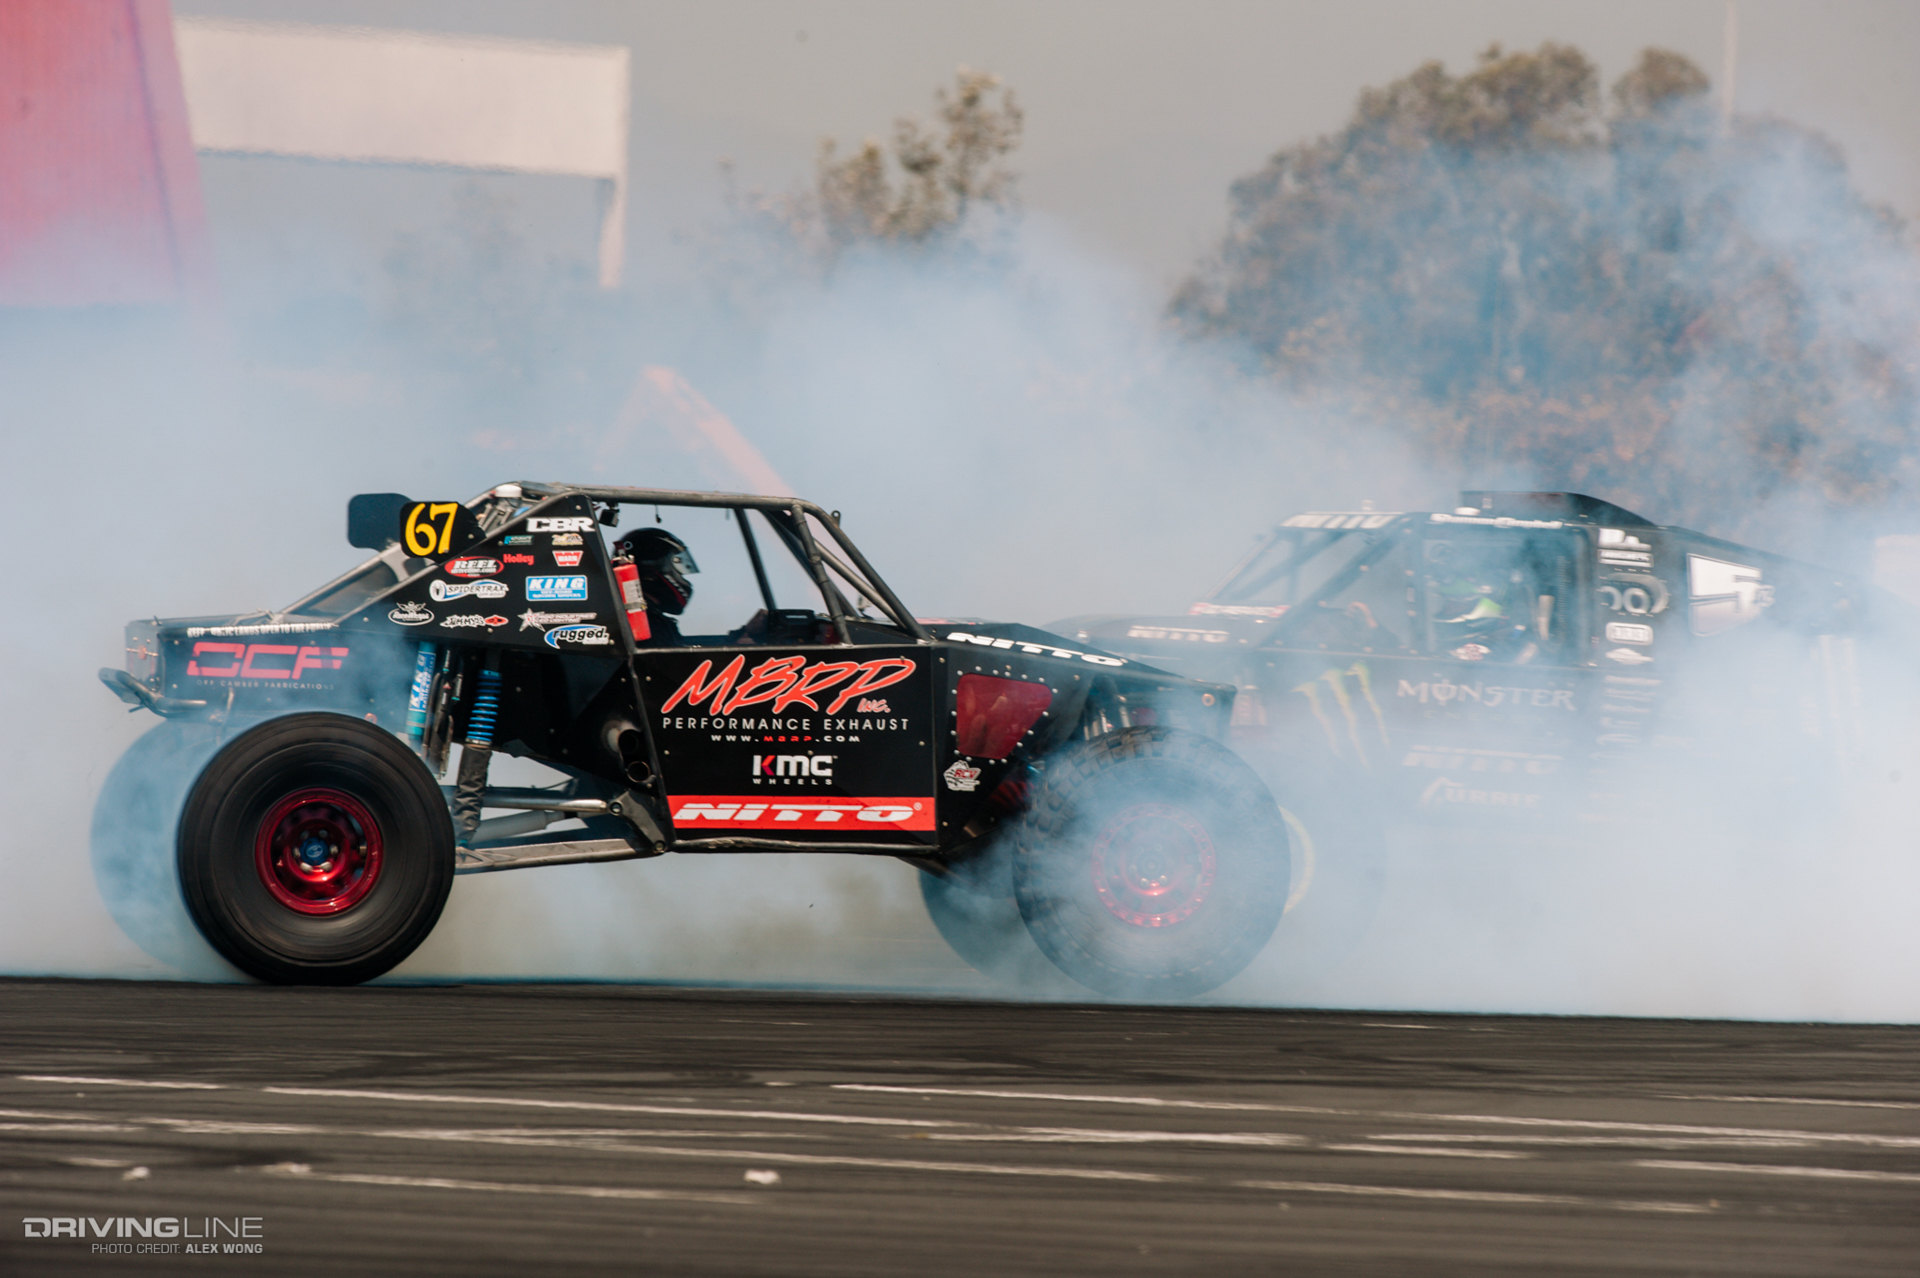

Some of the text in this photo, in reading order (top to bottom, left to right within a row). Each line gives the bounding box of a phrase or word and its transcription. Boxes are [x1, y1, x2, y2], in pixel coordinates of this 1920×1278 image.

[405, 502, 458, 556] 67
[527, 517, 597, 532] CBR
[453, 560, 497, 568] REEL
[503, 553, 534, 565] Holley
[529, 578, 584, 589] KING
[947, 632, 1123, 667] NITTO
[220, 680, 259, 688] CAMBER
[661, 654, 916, 716] MBRP
[1397, 674, 1576, 711] MONSTER
[662, 717, 909, 731] PERFORMANCE EXHAUST
[672, 803, 914, 822] NITTO
